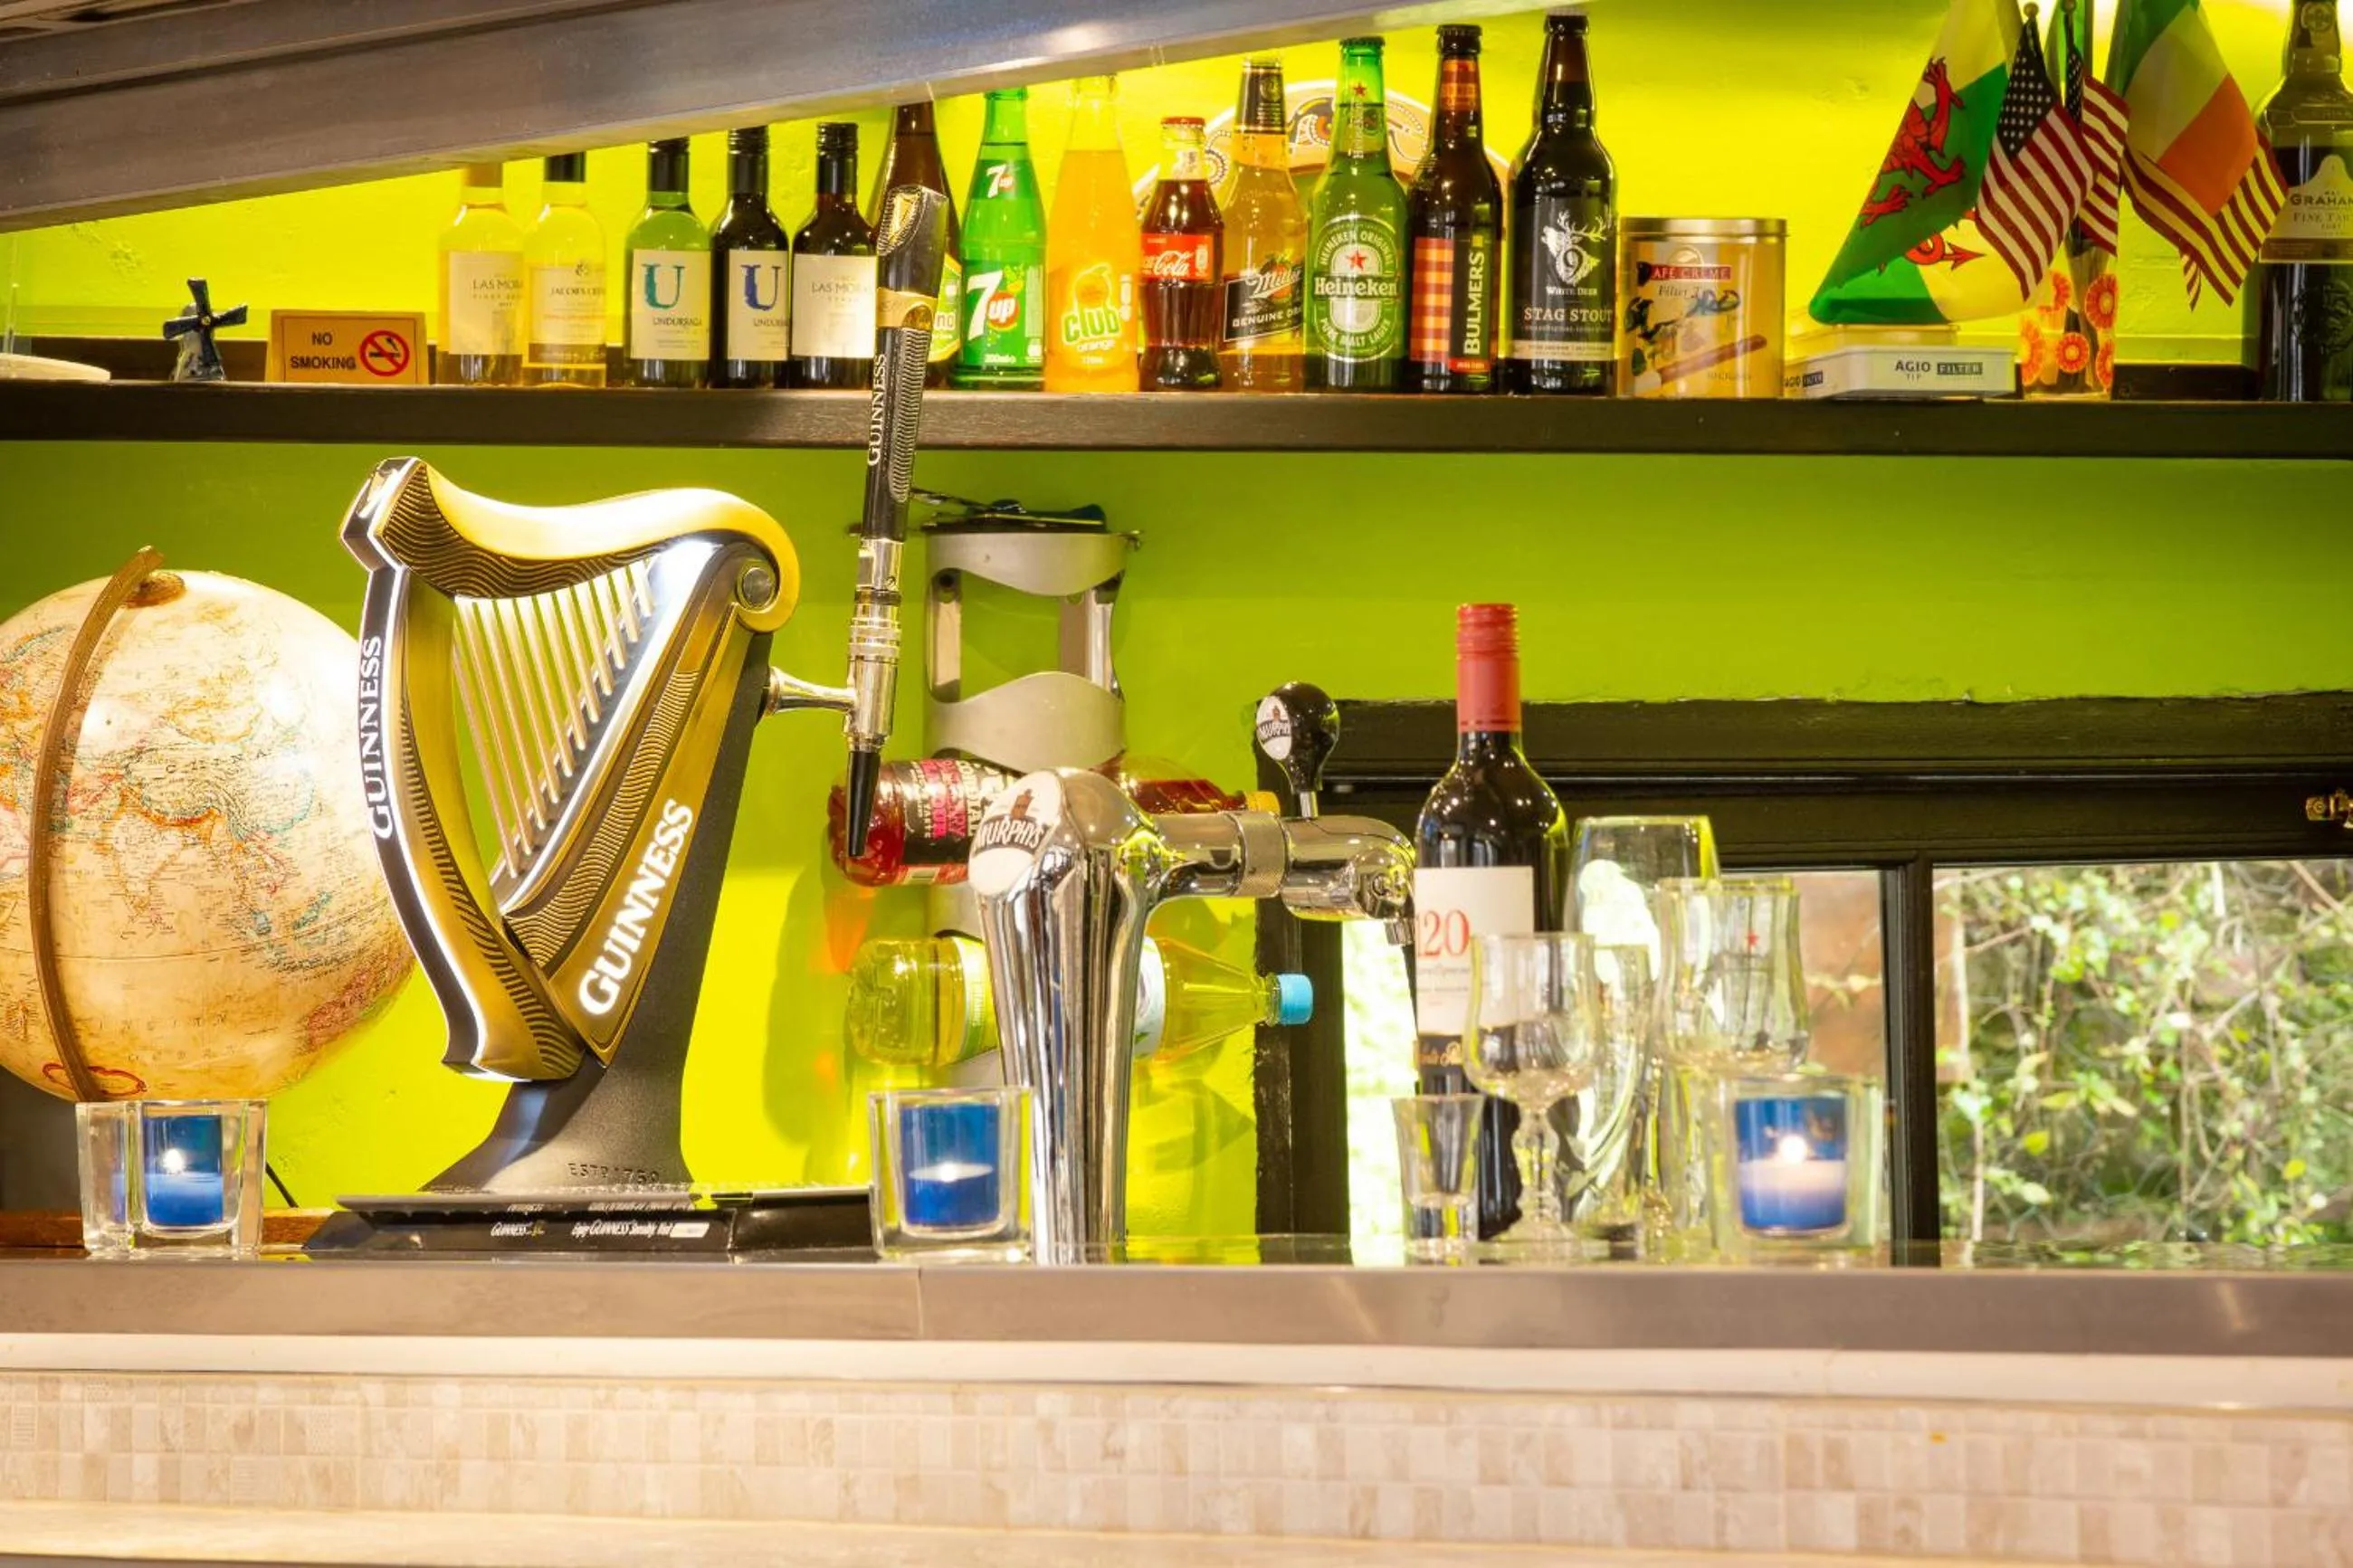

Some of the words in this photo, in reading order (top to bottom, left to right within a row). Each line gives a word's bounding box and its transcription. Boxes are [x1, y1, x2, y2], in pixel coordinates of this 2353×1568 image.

[472, 280, 494, 290] LAS
[642, 263, 685, 310] U
[740, 263, 781, 310] U
[1314, 277, 1397, 296] Heineken
[966, 270, 1017, 340] 7up
[1232, 309, 1284, 328] GENUINE
[1463, 252, 1484, 355] BULMERS
[1523, 307, 1565, 321] STAG
[1569, 308, 1613, 322] STOUT
[311, 332, 333, 346] NO
[290, 356, 357, 370] SMOKING
[1895, 360, 1930, 373] AGIO
[867, 354, 886, 466] GUINNESS
[360, 634, 394, 840] GUINNESS
[577, 797, 695, 1015] GUINNESS
